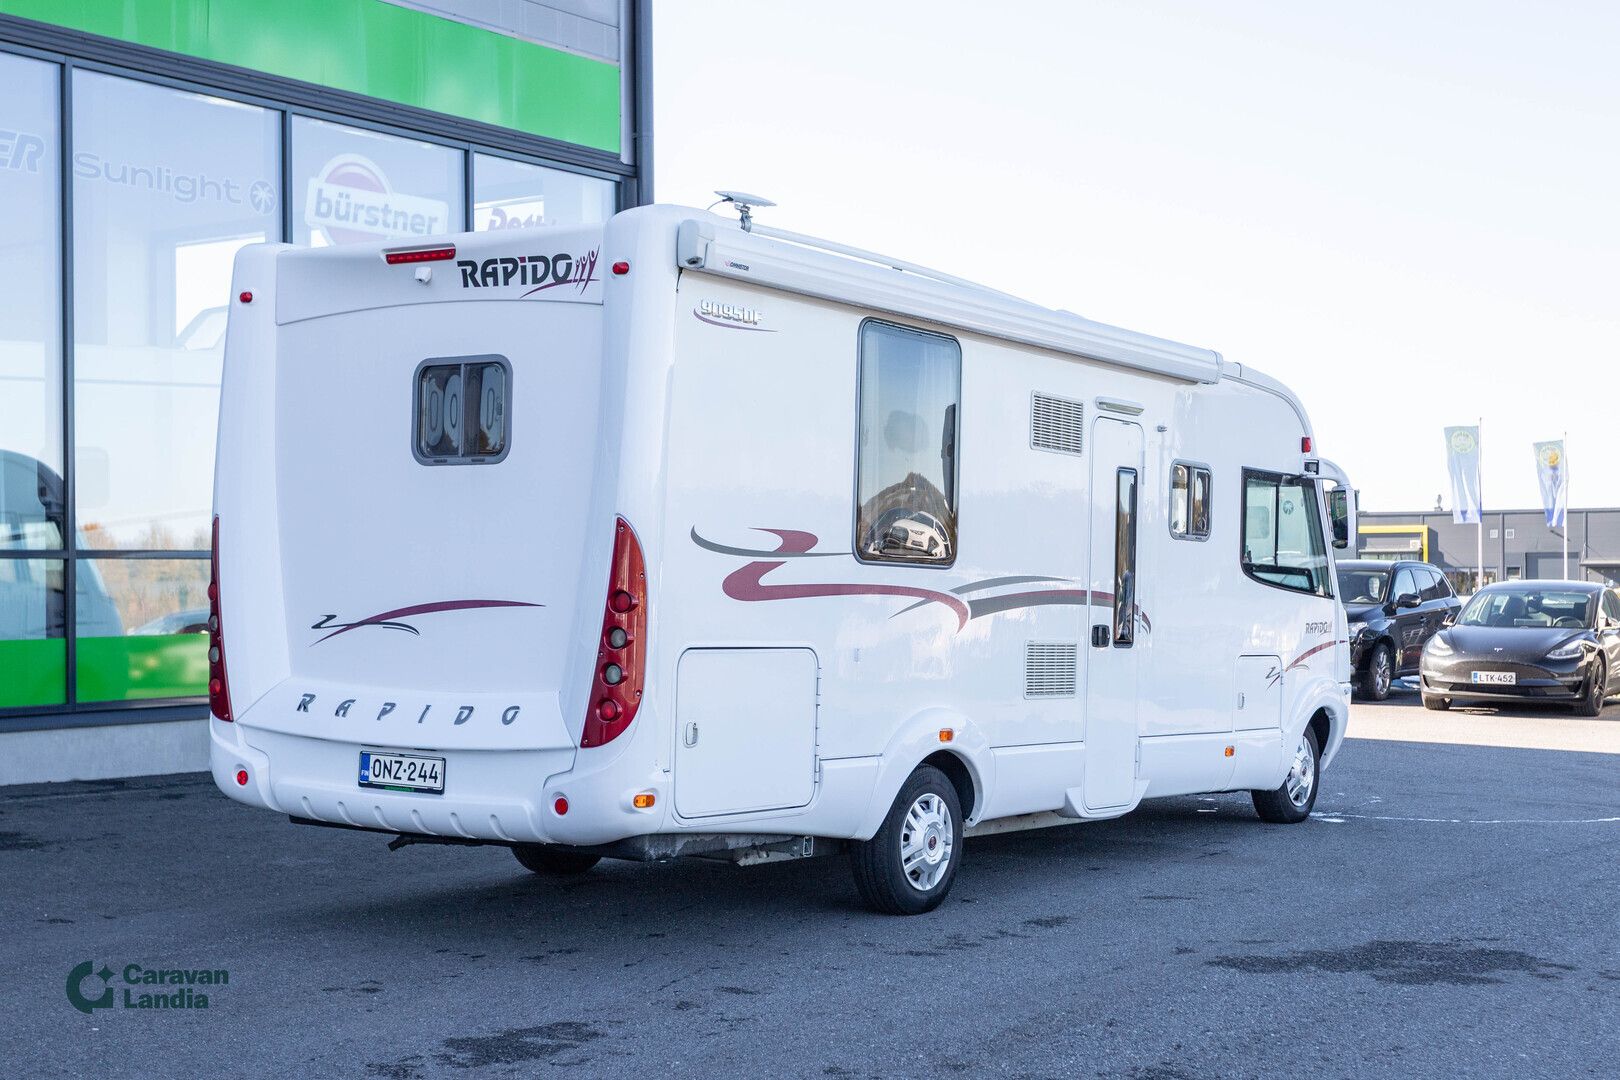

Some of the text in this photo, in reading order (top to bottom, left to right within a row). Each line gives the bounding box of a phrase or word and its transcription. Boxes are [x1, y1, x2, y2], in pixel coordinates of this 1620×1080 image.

[74, 152, 242, 204] Sunlight
[314, 187, 439, 235] bürstner
[1478, 674, 1514, 683] LTK-452
[297, 693, 521, 726] RAPIDO
